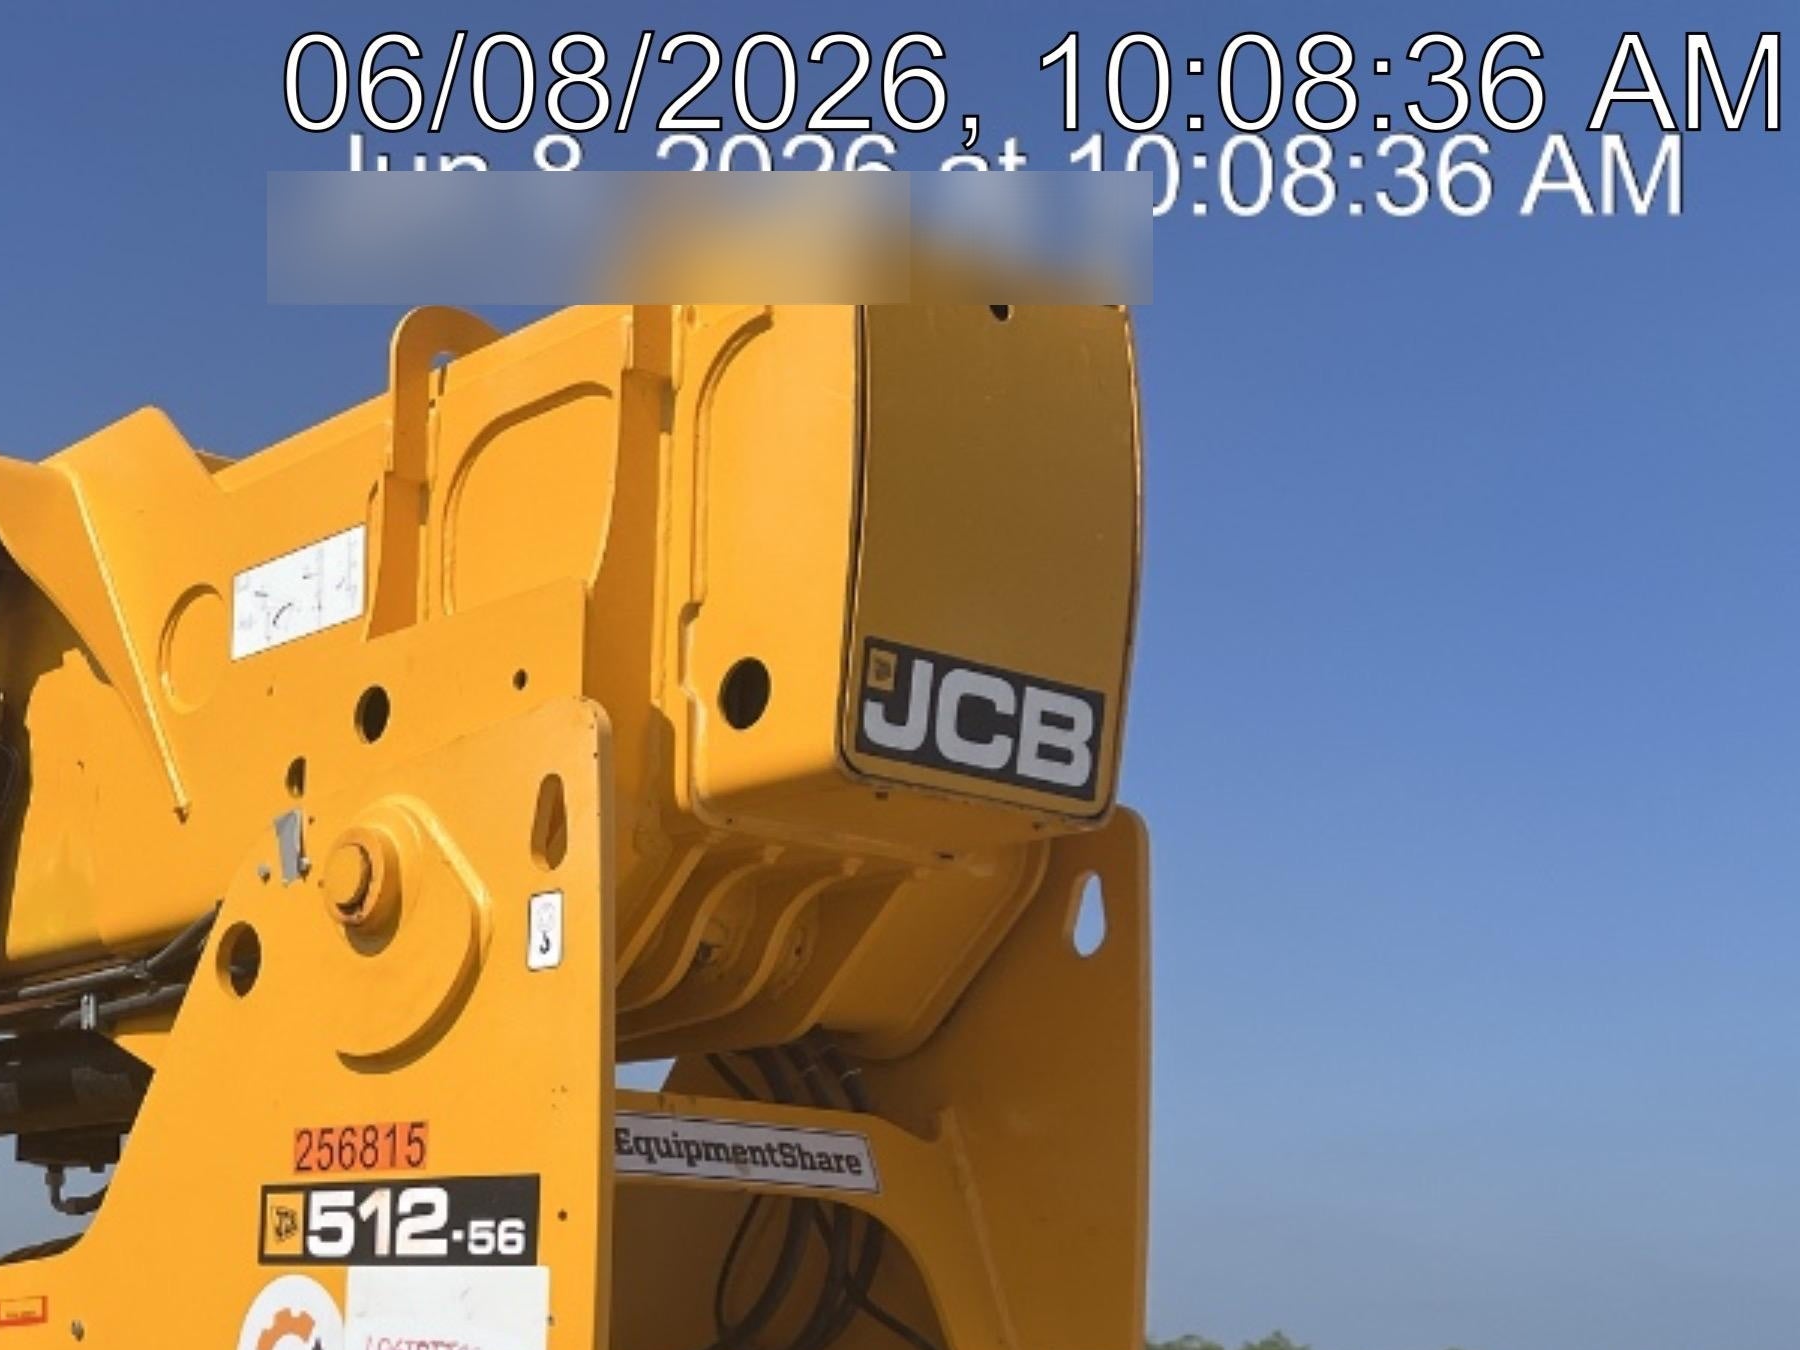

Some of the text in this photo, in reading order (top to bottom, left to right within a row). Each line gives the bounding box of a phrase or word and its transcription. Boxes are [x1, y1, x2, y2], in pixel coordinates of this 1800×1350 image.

[863, 658, 1094, 788] JCB
[295, 1121, 428, 1172] 256815
[614, 1127, 863, 1176] EquipmentShare
